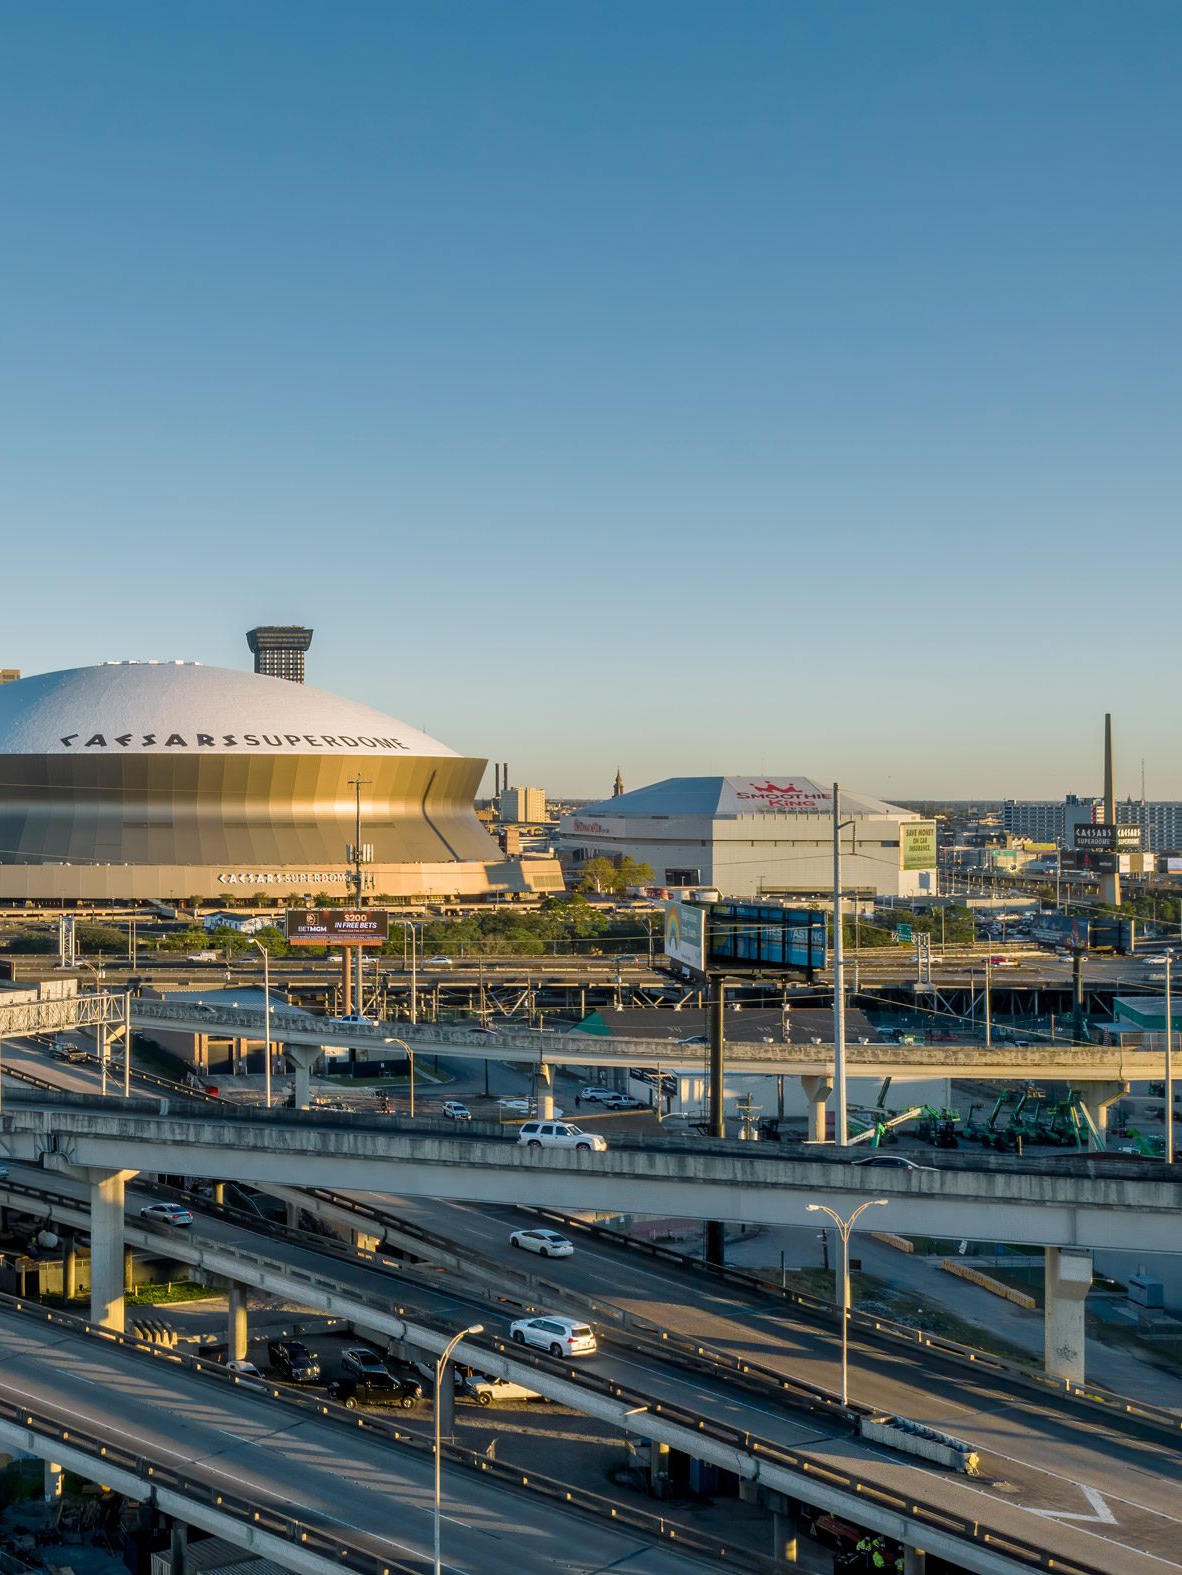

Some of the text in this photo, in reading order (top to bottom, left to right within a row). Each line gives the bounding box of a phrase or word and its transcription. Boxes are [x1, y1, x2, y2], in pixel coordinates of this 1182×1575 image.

[59, 733, 411, 751] CAESARS SUPERDOME
[905, 828, 934, 837] SAVE MONEY
[1075, 828, 1112, 837] CAESARS
[1117, 828, 1141, 837] CAESARS
[218, 872, 351, 884] CAESARS SUPERDOM
[344, 914, 367, 922] $200
